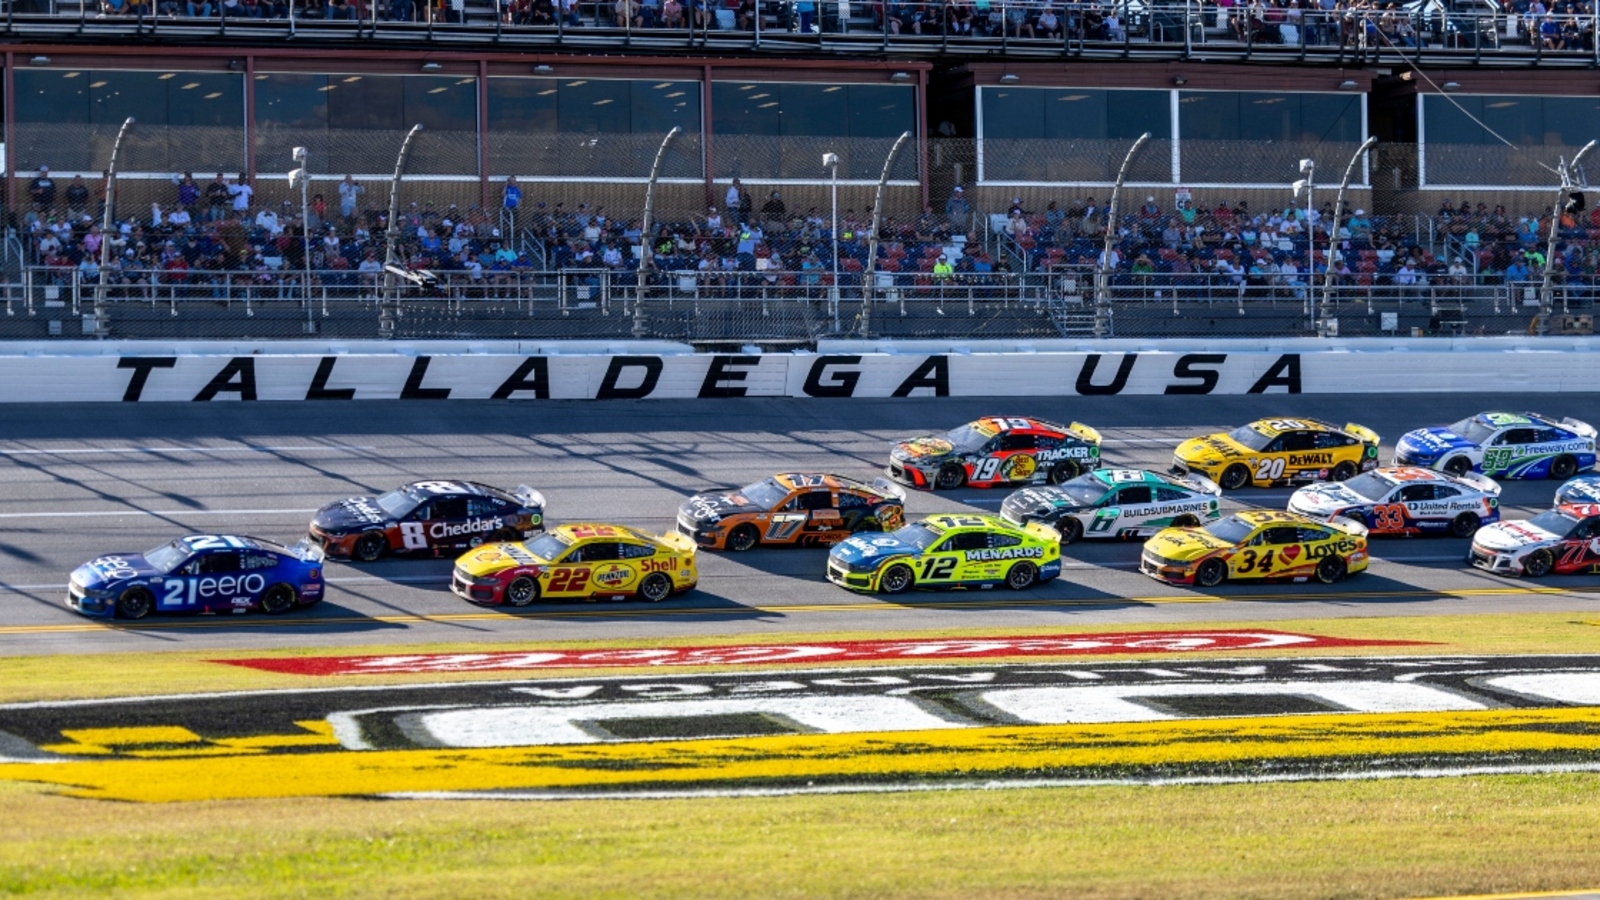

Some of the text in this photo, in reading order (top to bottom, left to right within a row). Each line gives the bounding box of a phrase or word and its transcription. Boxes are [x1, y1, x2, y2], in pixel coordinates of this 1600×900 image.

[117, 353, 1303, 402] TALLADEGA USA
[990, 417, 1033, 430] 19
[1036, 447, 1088, 460] TRACKER
[1481, 446, 1513, 470] 99
[1524, 441, 1588, 455] Freeway.com
[971, 457, 1000, 480] 19
[1255, 458, 1286, 480] 20
[787, 473, 825, 488] 17
[1123, 502, 1208, 518] BUILDSUBMARINES
[1373, 503, 1405, 528] 33
[1419, 501, 1481, 511] United Rentals
[429, 516, 504, 538] Cheddar's
[764, 514, 807, 541] 17
[937, 516, 985, 528] 12
[1087, 507, 1121, 534] 6
[182, 535, 247, 551] 21
[400, 522, 428, 549] 8
[965, 546, 1045, 561] MENARDS
[1237, 549, 1275, 574] 34
[1560, 539, 1592, 565] 71
[641, 557, 677, 572] Shell
[920, 557, 958, 579] 12
[199, 574, 265, 597] eero
[547, 568, 592, 592] 22
[163, 578, 198, 605] 21
